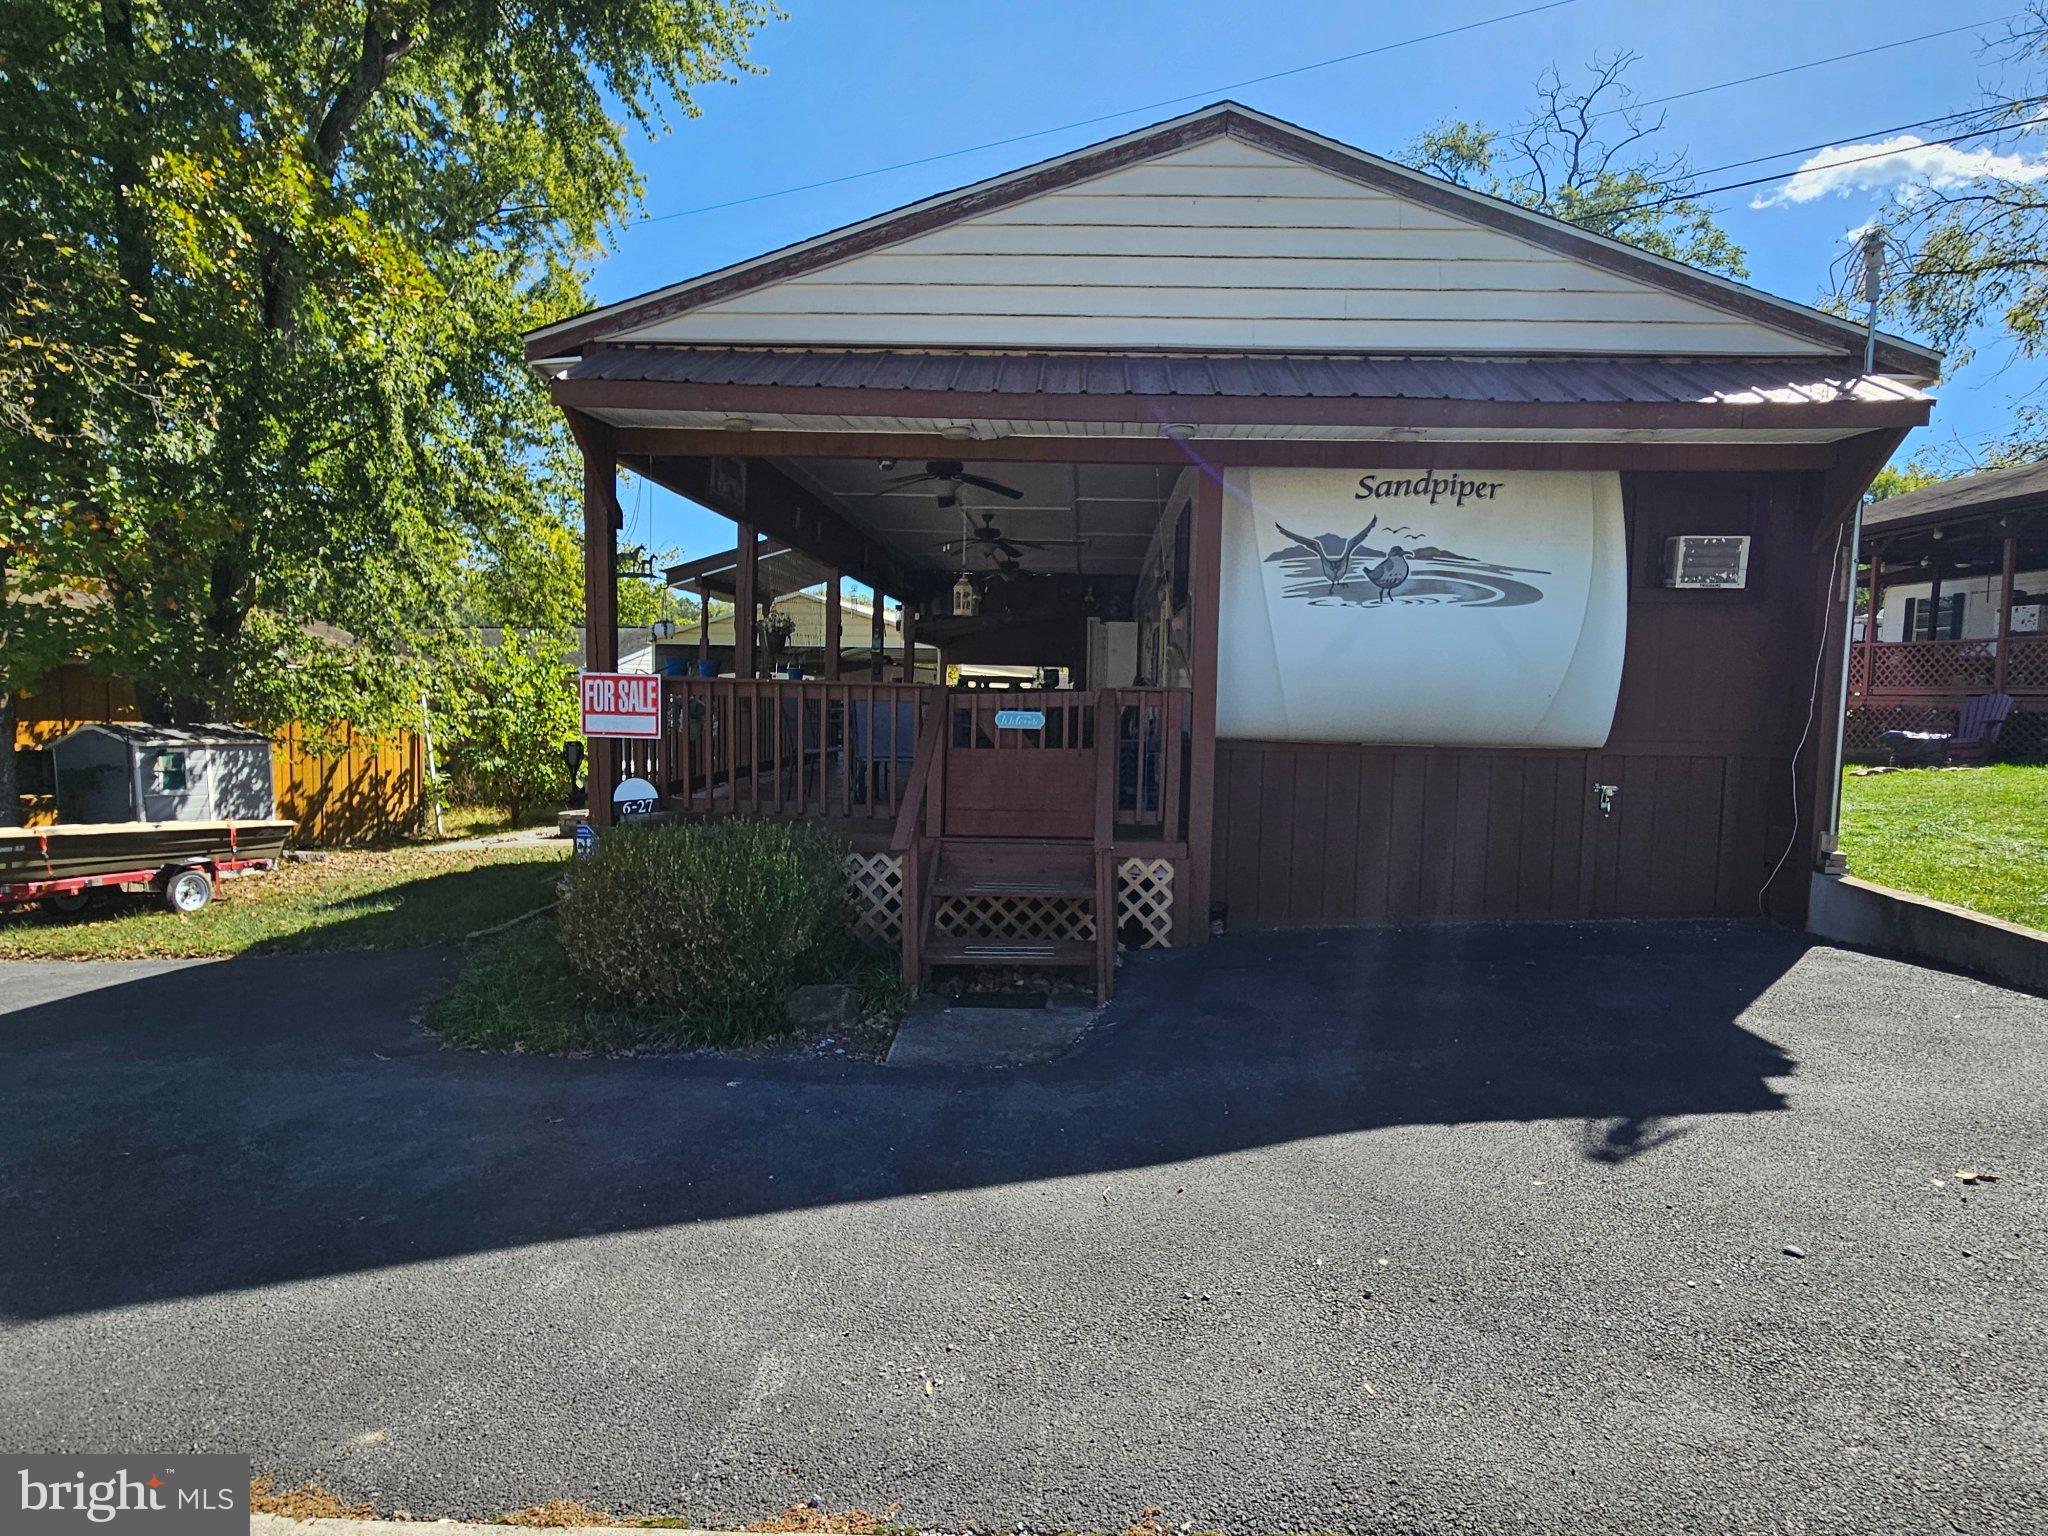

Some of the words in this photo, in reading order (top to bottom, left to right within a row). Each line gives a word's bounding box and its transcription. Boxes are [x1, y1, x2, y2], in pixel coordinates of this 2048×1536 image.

[1354, 469, 1506, 506] Sandpiper
[584, 679, 615, 712] FOR
[618, 679, 657, 713] SALE
[622, 799, 653, 814] 6-27
